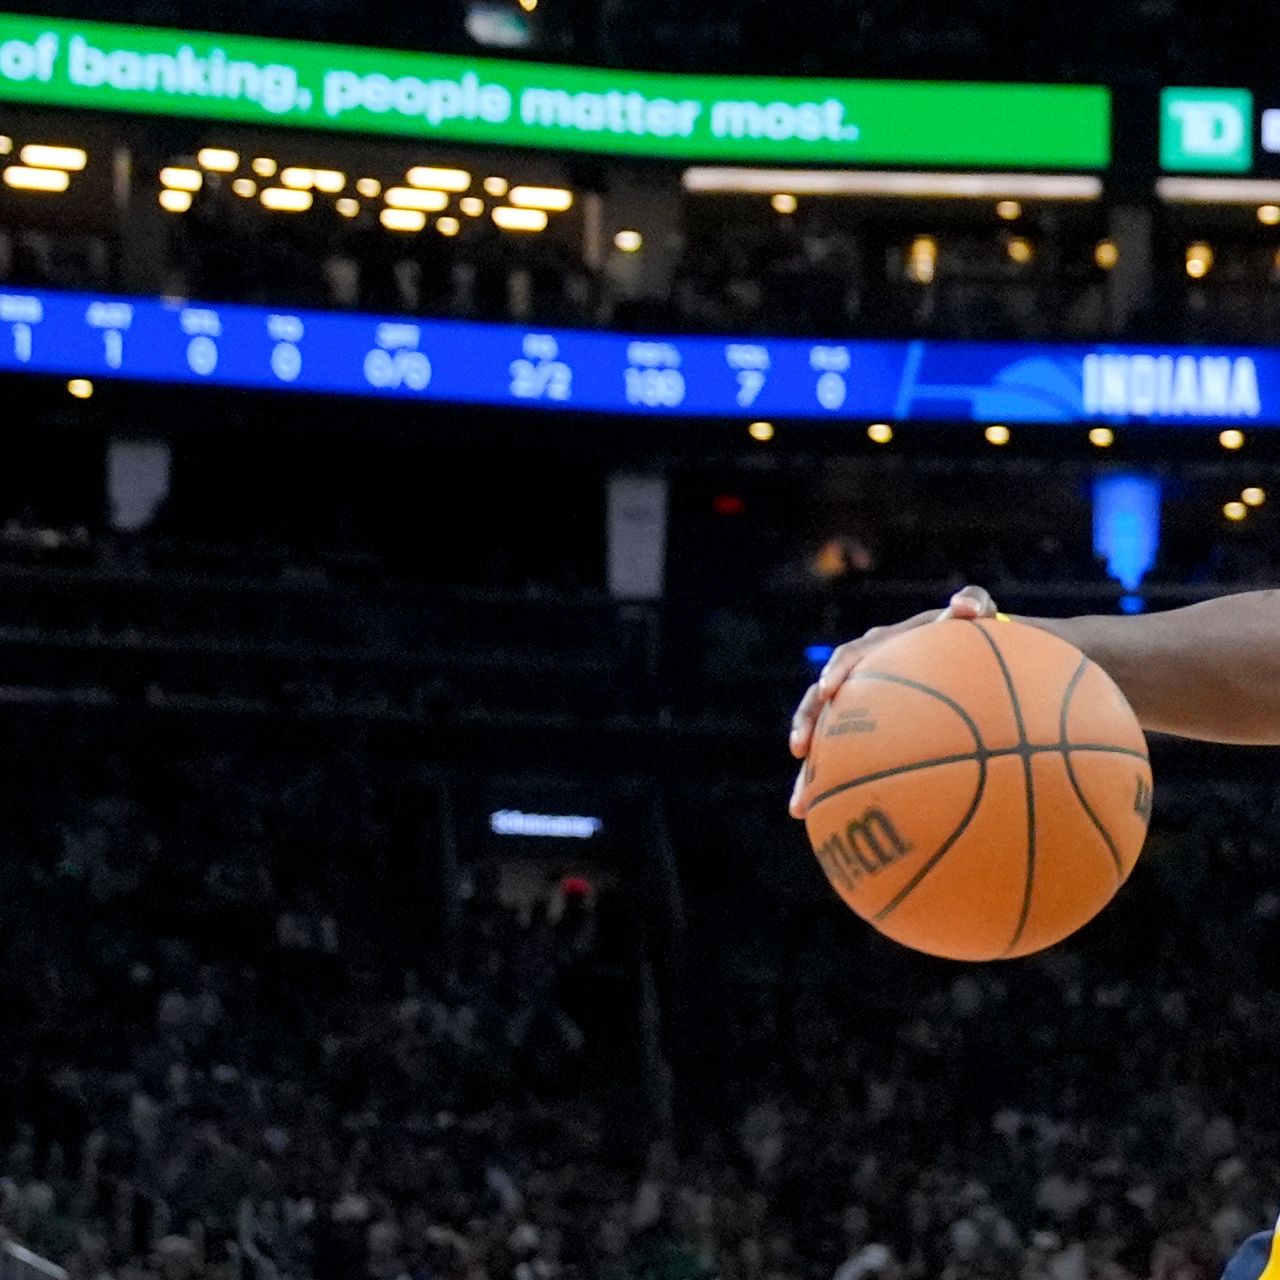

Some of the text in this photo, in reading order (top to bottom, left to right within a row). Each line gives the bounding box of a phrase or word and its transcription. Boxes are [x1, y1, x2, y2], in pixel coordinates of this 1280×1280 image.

[0, 33, 857, 140] of banking, people matter most.
[1168, 101, 1243, 156] TD
[1083, 354, 1260, 416] INDIANA
